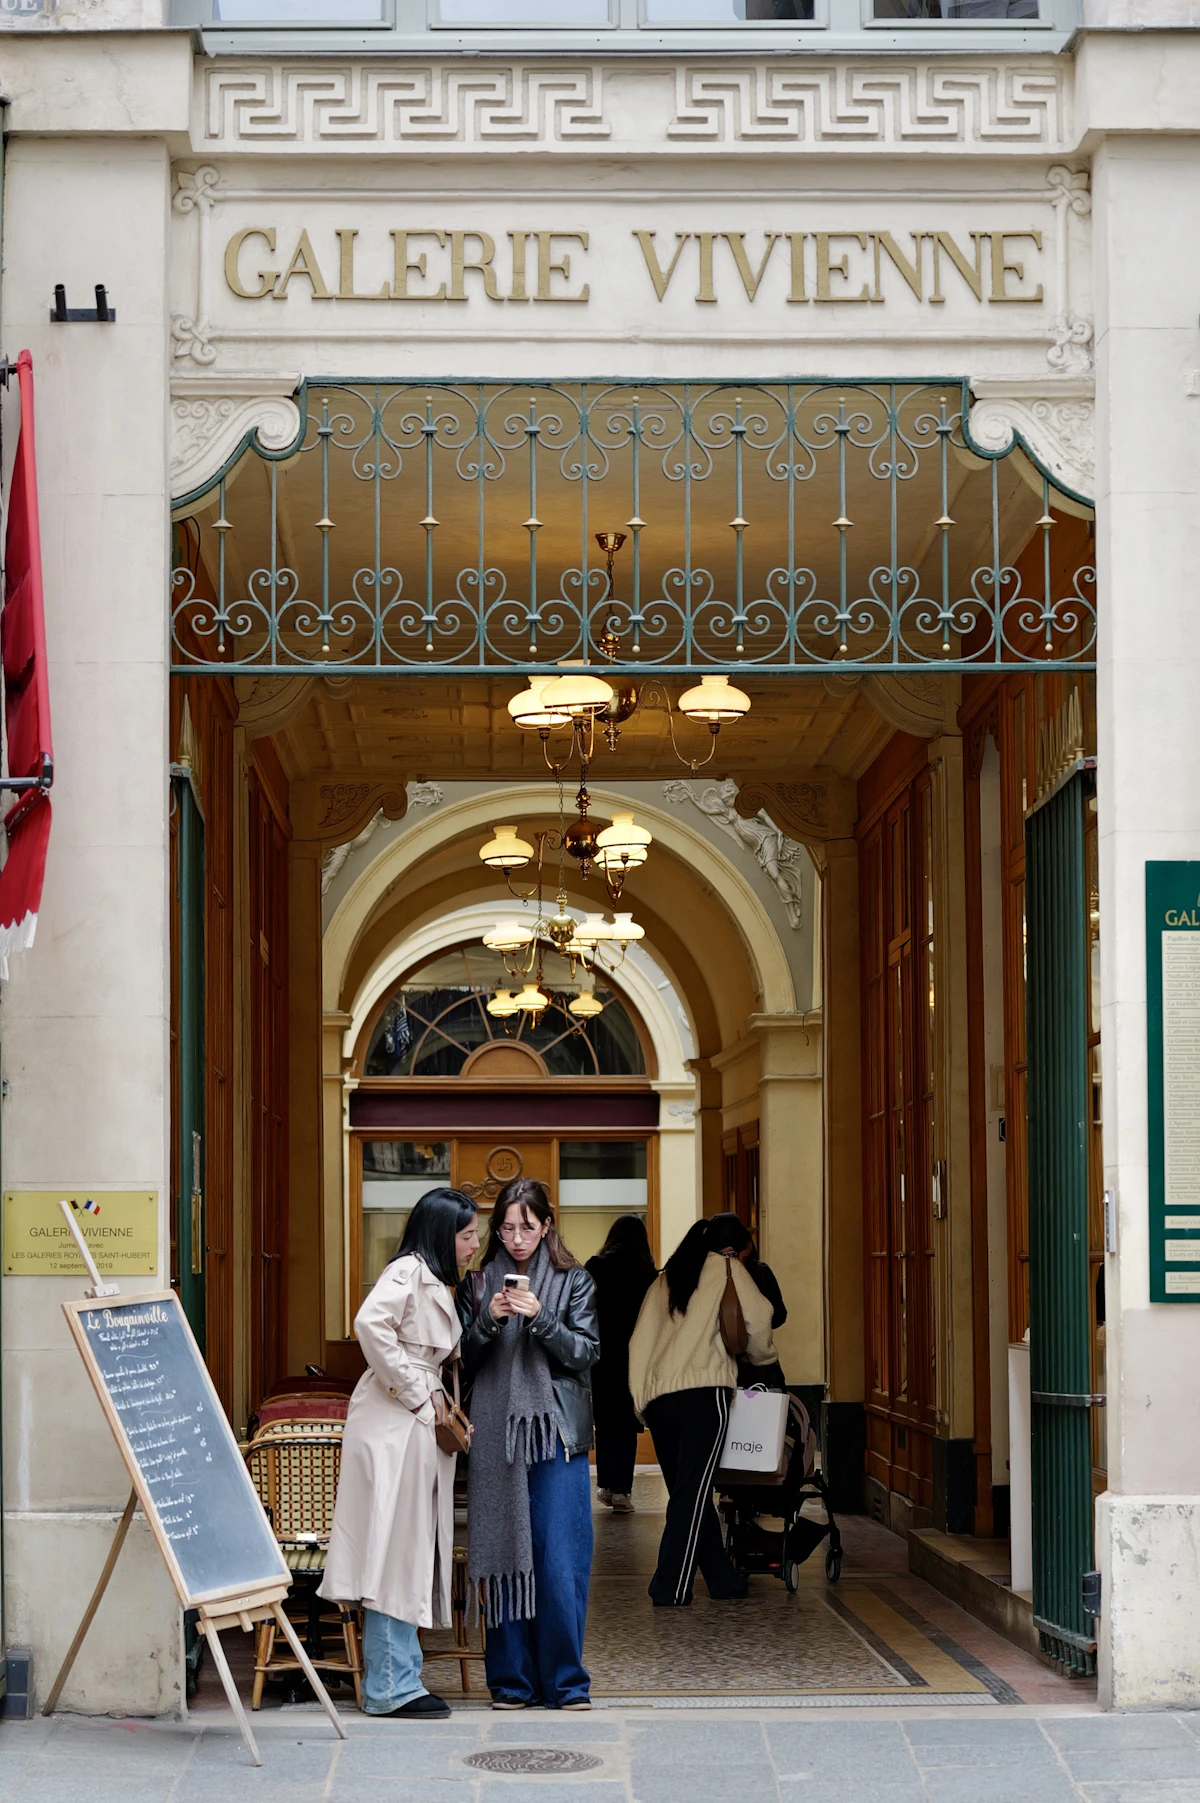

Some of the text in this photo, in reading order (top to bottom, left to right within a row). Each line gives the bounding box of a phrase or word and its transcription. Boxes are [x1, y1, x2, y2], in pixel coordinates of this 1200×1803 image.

[224, 227, 1044, 303] GALERIE VIVIENNE
[496, 1157, 513, 1172] 25
[29, 1227, 133, 1237] GALERI VIVIENNE
[86, 1305, 168, 1332] Le Bougainville
[730, 1441, 763, 1454] maje
